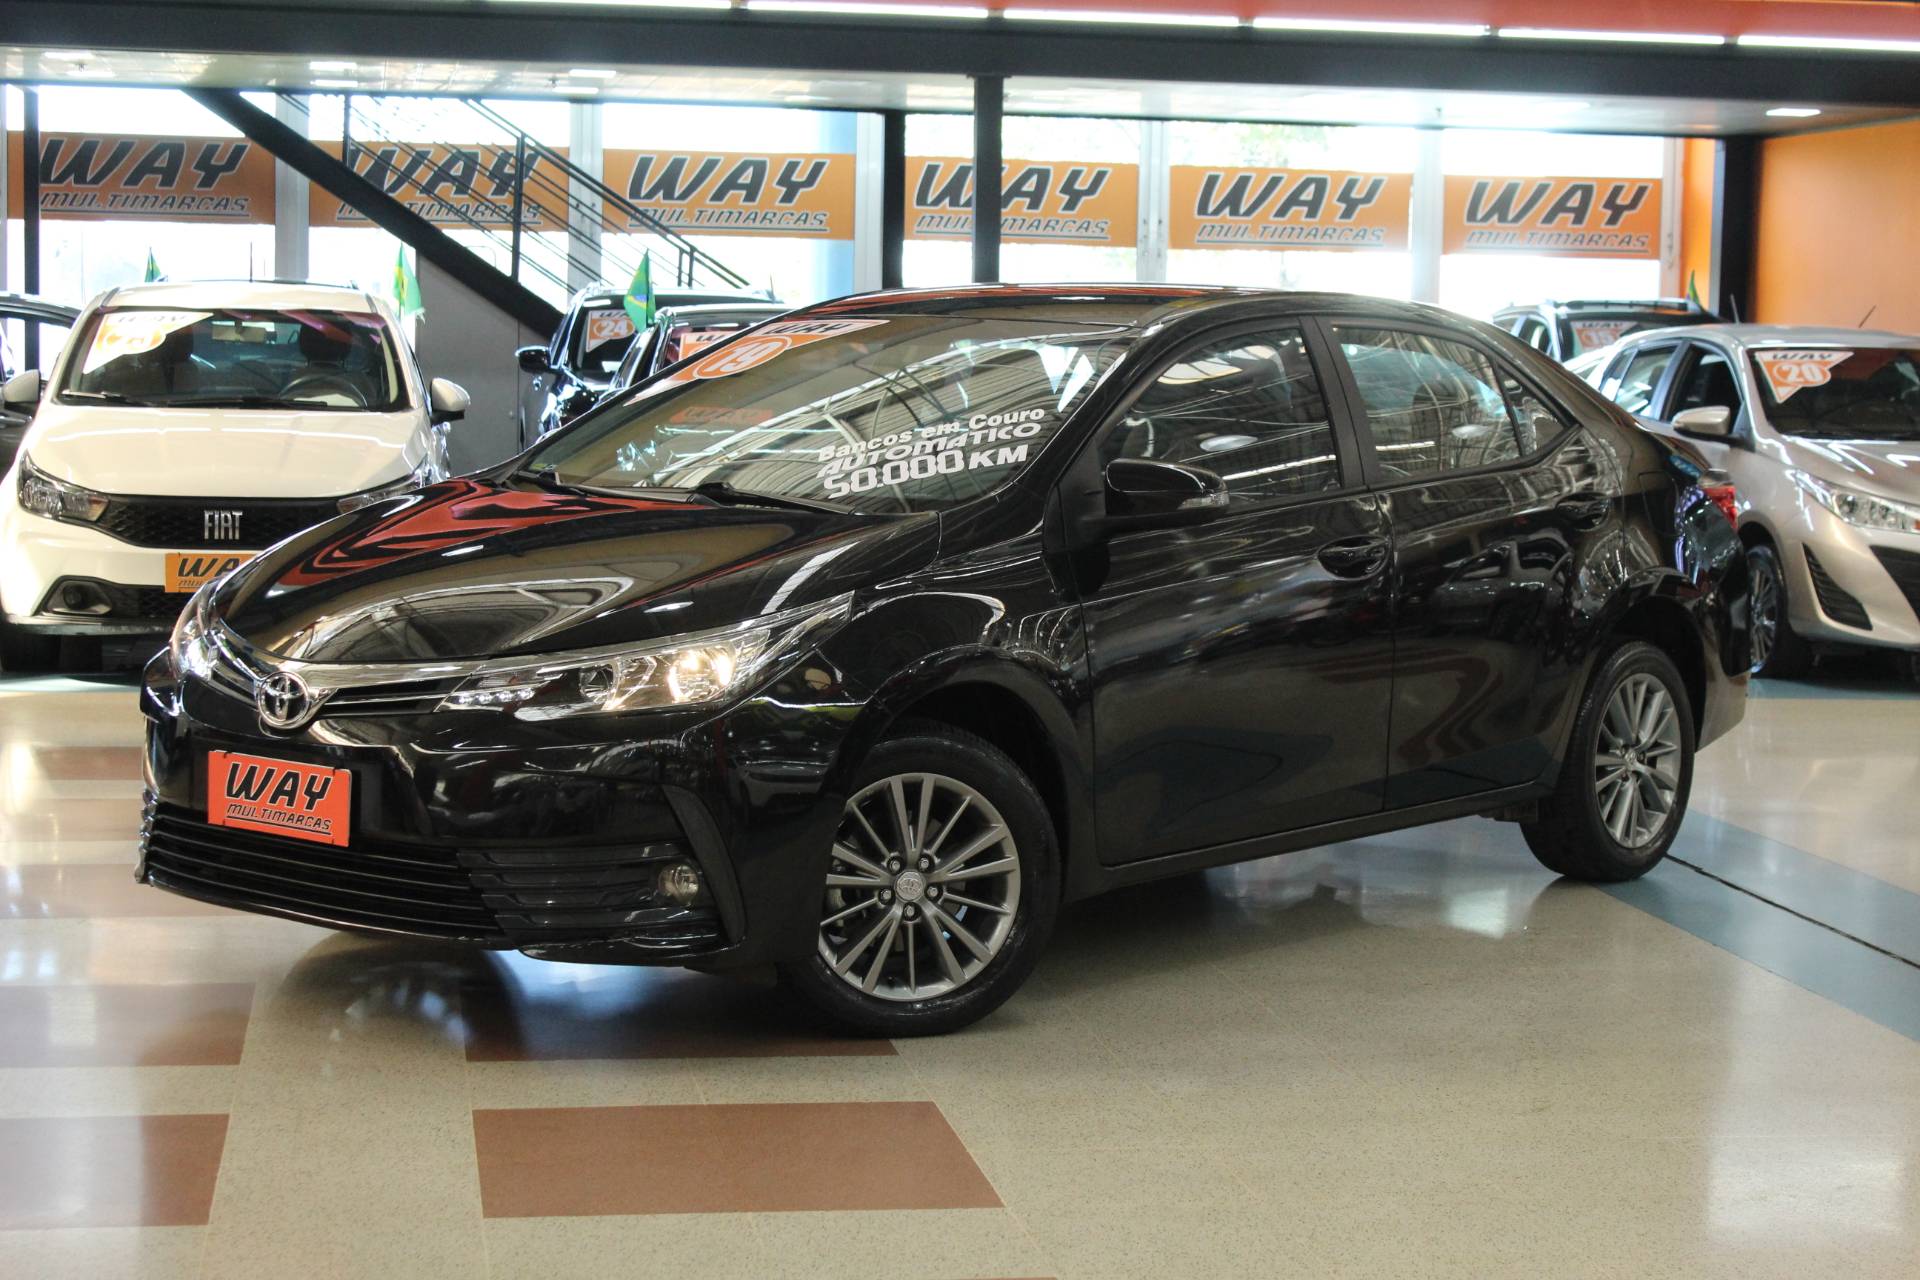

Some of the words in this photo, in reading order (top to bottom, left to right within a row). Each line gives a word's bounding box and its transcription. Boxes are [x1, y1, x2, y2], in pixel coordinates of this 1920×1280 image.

[39, 138, 250, 189] WAY
[349, 147, 542, 198] WAY
[628, 155, 829, 205] WAY
[41, 191, 249, 212] MULTIMARCAS
[915, 162, 1112, 214] WAY
[1195, 171, 1387, 222] WAY
[1465, 179, 1652, 228] WAY
[1198, 224, 1385, 242] MULTIMARCAS
[1467, 231, 1650, 247] MULTIMARCAS
[599, 319, 628, 337] 24
[762, 323, 853, 335] WAY
[703, 340, 784, 373] 19
[1779, 362, 1825, 383] 20
[816, 422, 1042, 479] AUTOMATICO
[818, 428, 914, 462] Bancos
[921, 419, 960, 437] em
[968, 407, 1046, 430] Couro
[823, 449, 965, 499] 50.000
[968, 444, 1029, 470] KM
[204, 510, 243, 540] FIAT
[178, 558, 240, 577] WA
[225, 762, 333, 812] WAY
[227, 803, 332, 830] MULTIMARCAS
